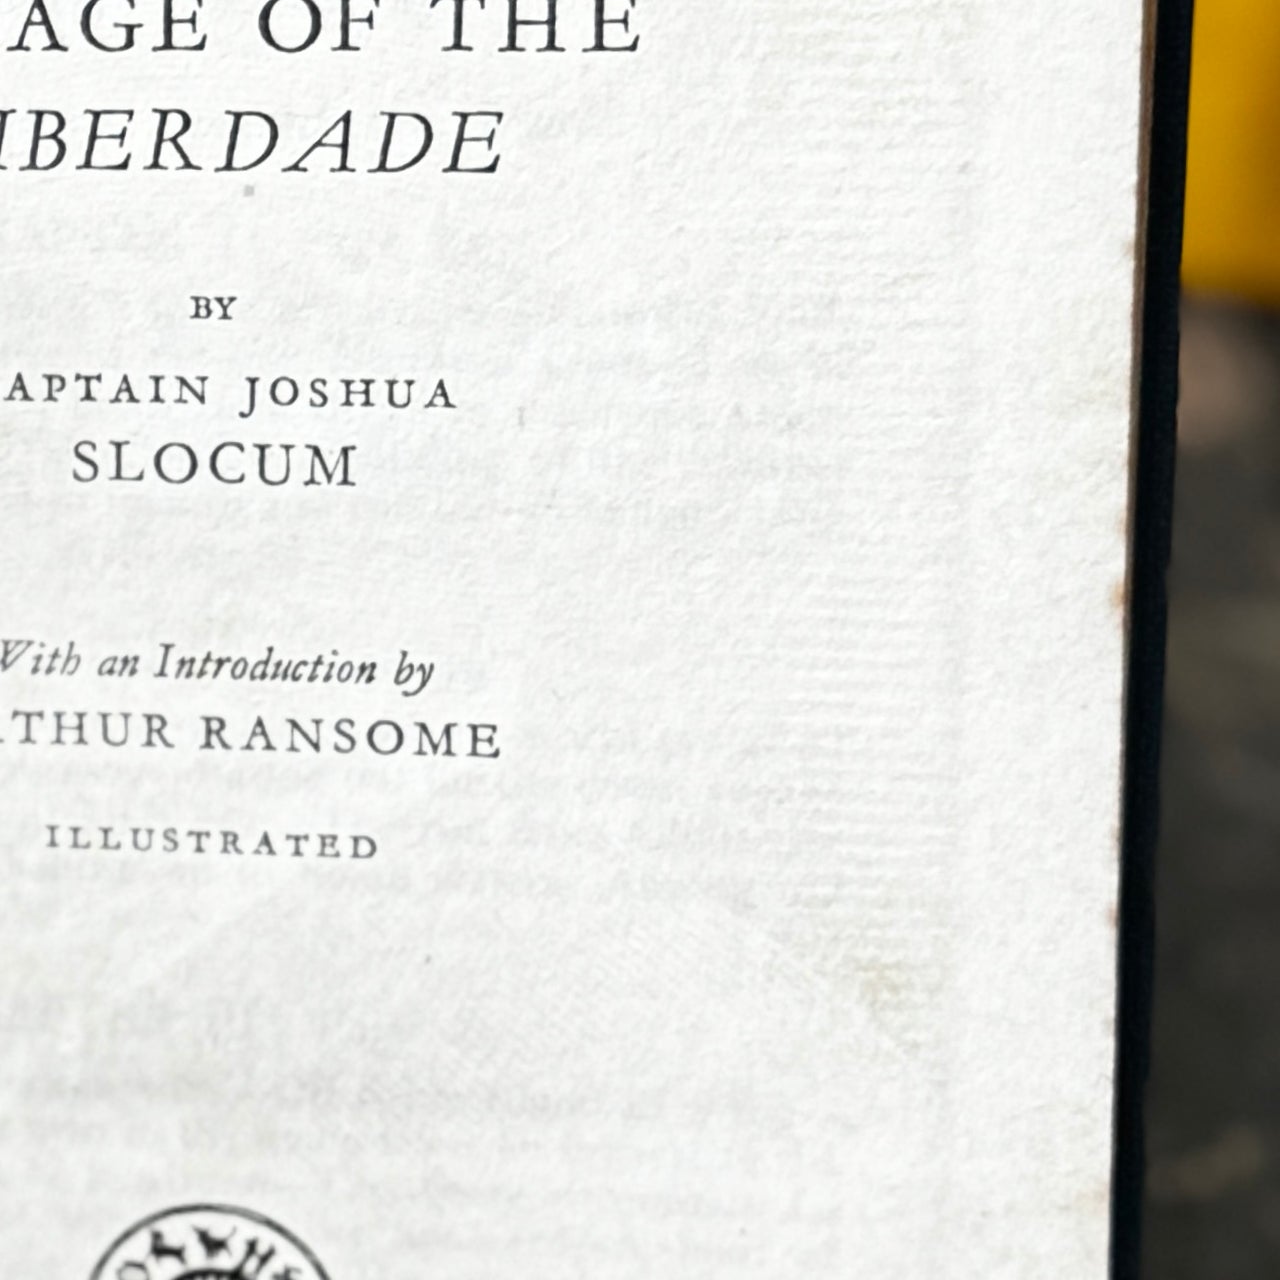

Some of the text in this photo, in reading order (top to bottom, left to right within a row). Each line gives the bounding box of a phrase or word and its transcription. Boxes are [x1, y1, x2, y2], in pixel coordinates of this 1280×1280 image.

[189, 294, 238, 322] BY
[237, 374, 457, 420] JOSHUA
[71, 438, 358, 488] SLOCUM
[96, 653, 141, 679] an
[153, 641, 379, 686] Introduction
[392, 648, 437, 699] by
[199, 714, 502, 761] RANSOME
[45, 823, 379, 861] ILLUSTRATED
